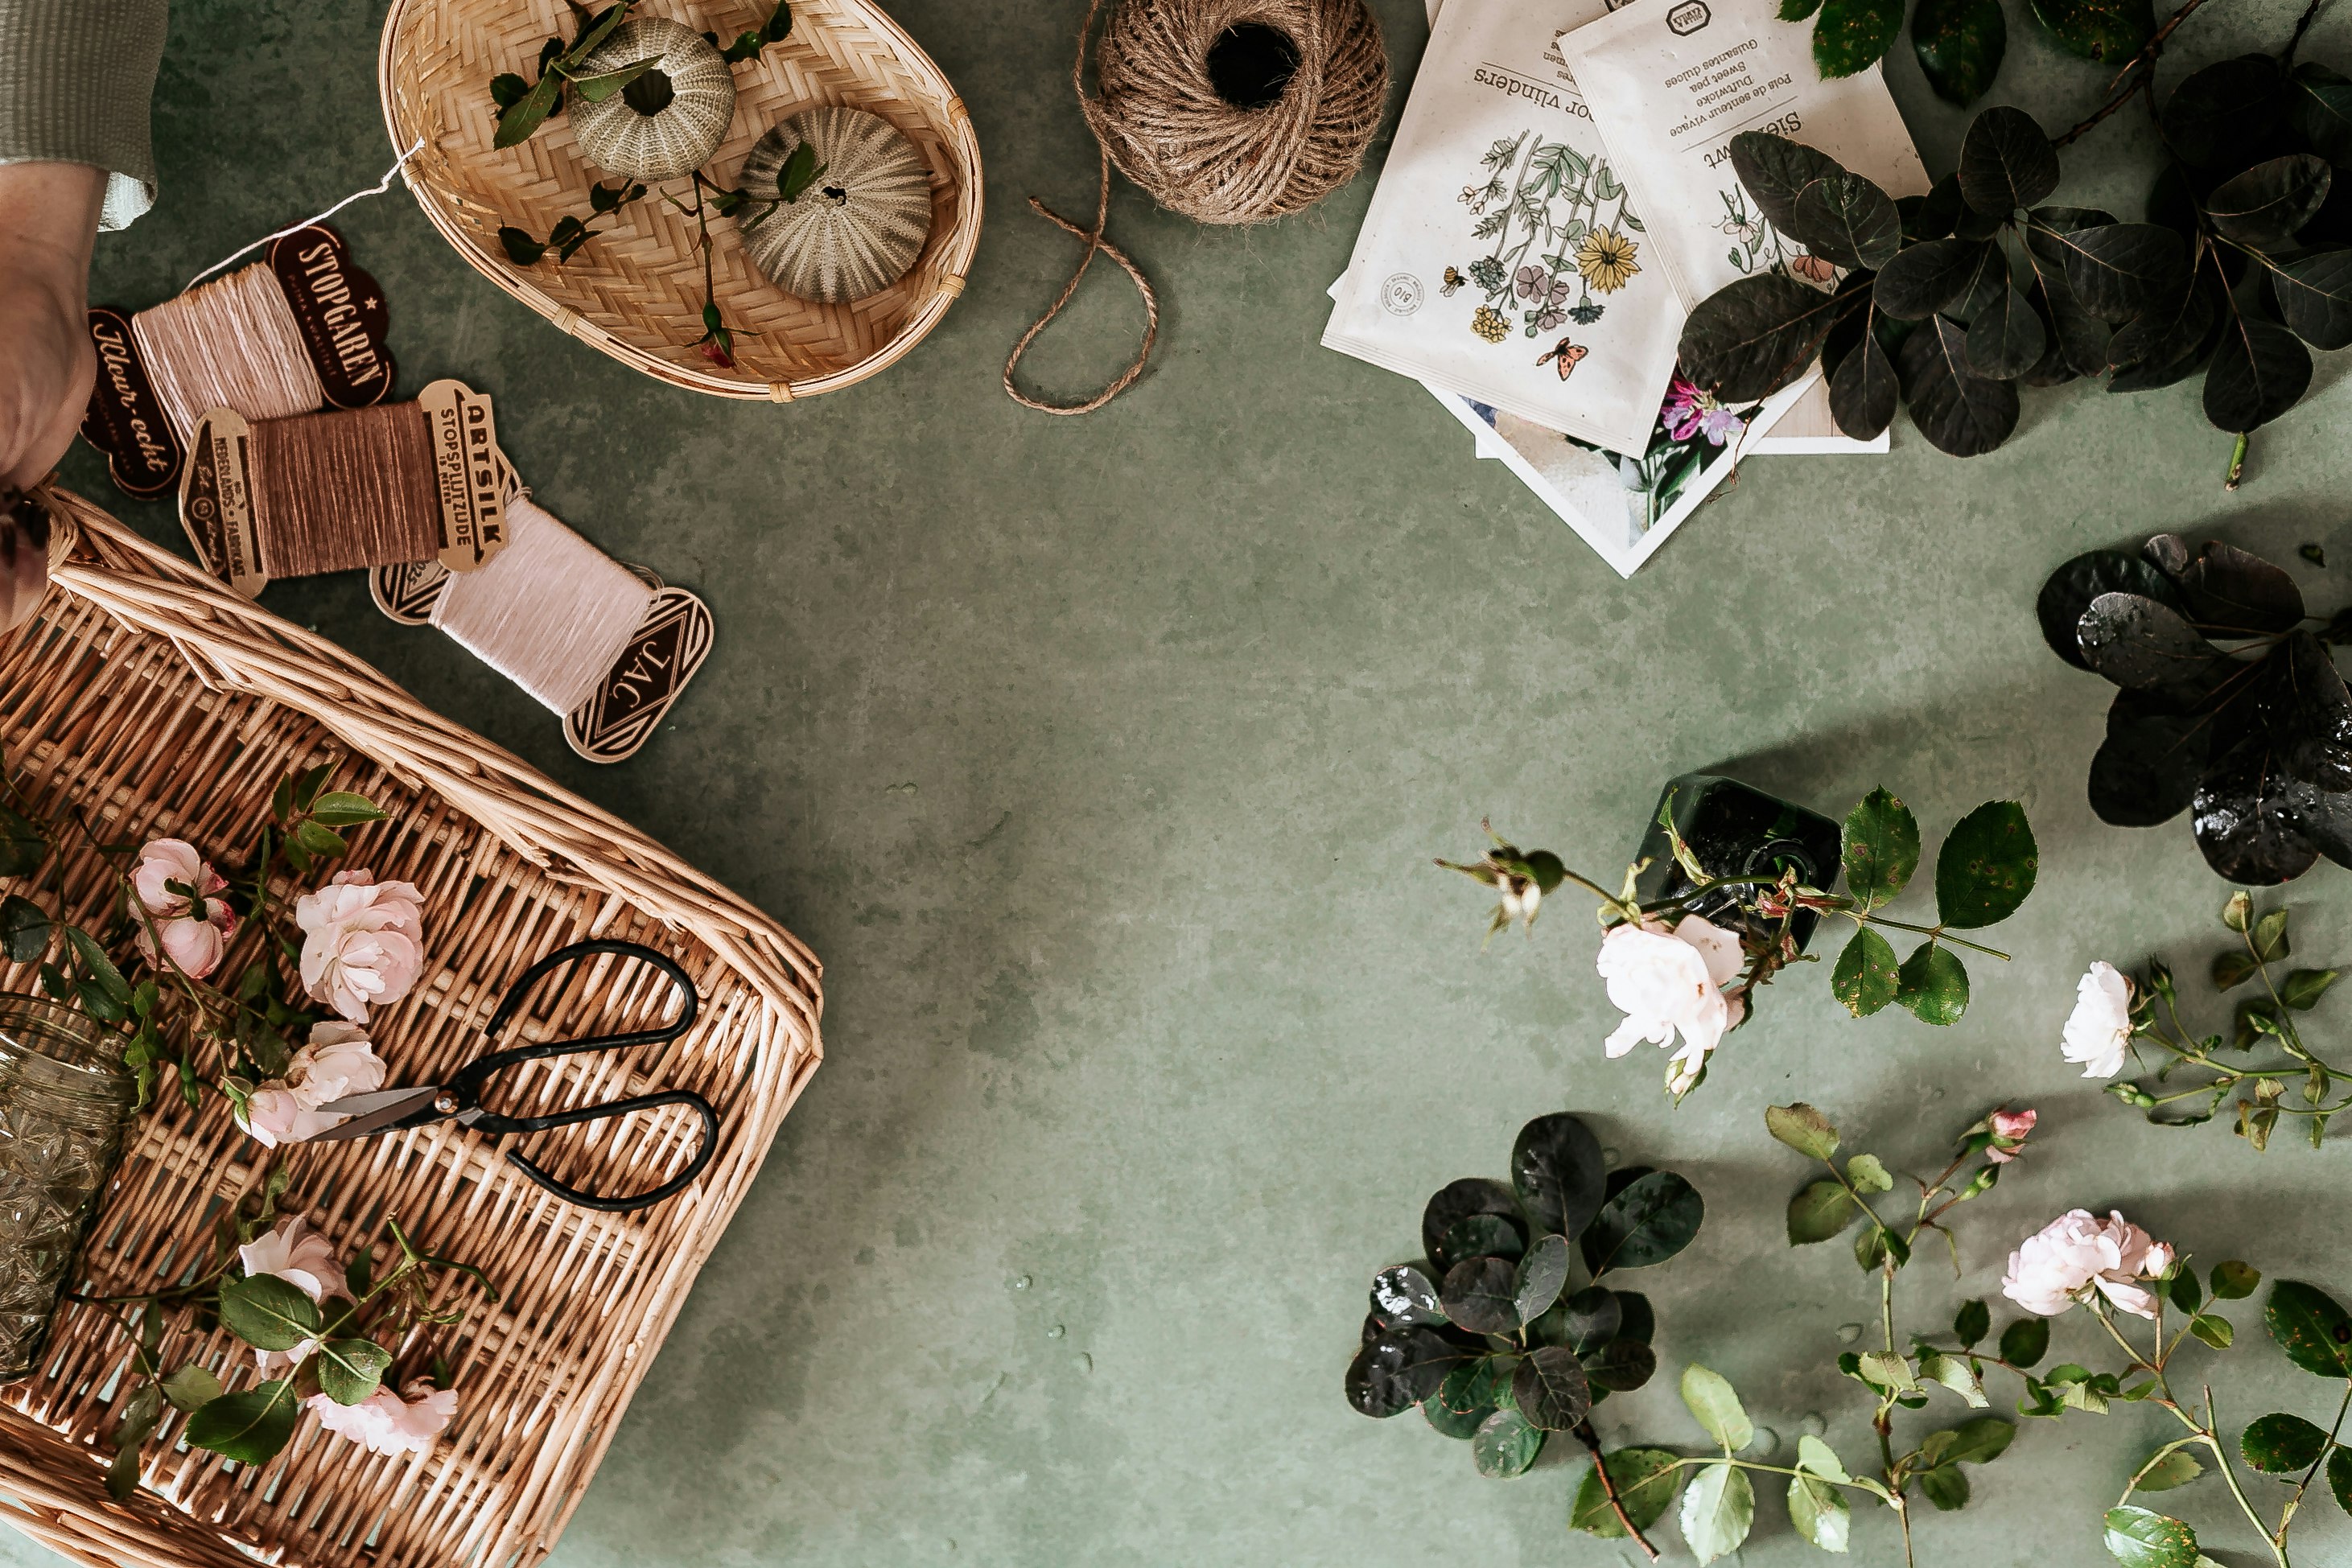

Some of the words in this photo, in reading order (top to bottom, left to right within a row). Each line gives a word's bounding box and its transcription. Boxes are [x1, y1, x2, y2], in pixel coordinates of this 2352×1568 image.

[1702, 39, 1758, 71] Guisantes
[1665, 66, 1701, 88] dulces
[1711, 61, 1746, 79] Sweet
[1768, 72, 1793, 90] Pois
[1474, 68, 1560, 109] vlinders
[1690, 76, 1710, 93] pea
[1696, 75, 1753, 107] Duftwicke
[1753, 84, 1766, 97] de
[1709, 92, 1752, 119] senteur
[1670, 114, 1707, 137] vivace
[1394, 286, 1412, 302] BIO
[299, 242, 383, 386] STOPGAREN
[94, 323, 168, 472] Kleur-echt
[214, 437, 236, 508] NEDERLANDS
[467, 405, 502, 544] ARTSILK
